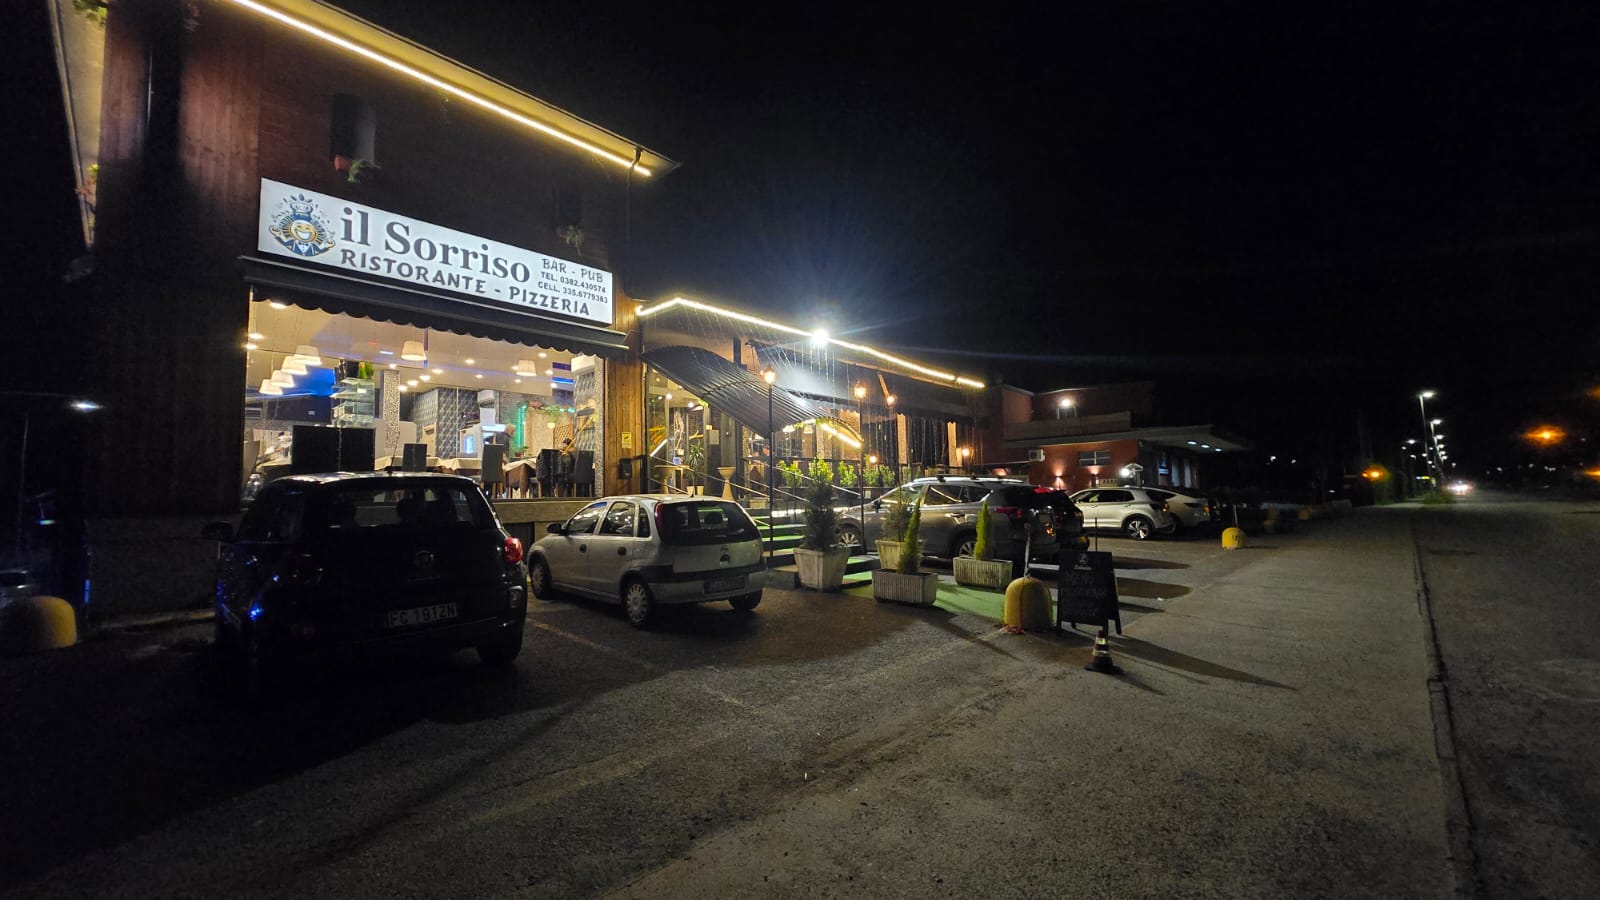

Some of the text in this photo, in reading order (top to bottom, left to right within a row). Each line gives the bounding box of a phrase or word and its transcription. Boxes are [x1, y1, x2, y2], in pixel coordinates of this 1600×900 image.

[340, 207, 530, 283] il Sorriso
[340, 249, 486, 294] RISTORANTE
[509, 286, 590, 316] PIZZERIA
[541, 271, 606, 293] TEL. 0382.430574
[542, 258, 567, 274] BAR
[581, 268, 603, 283] PUB
[538, 281, 608, 303] CELL. 335.6779383
